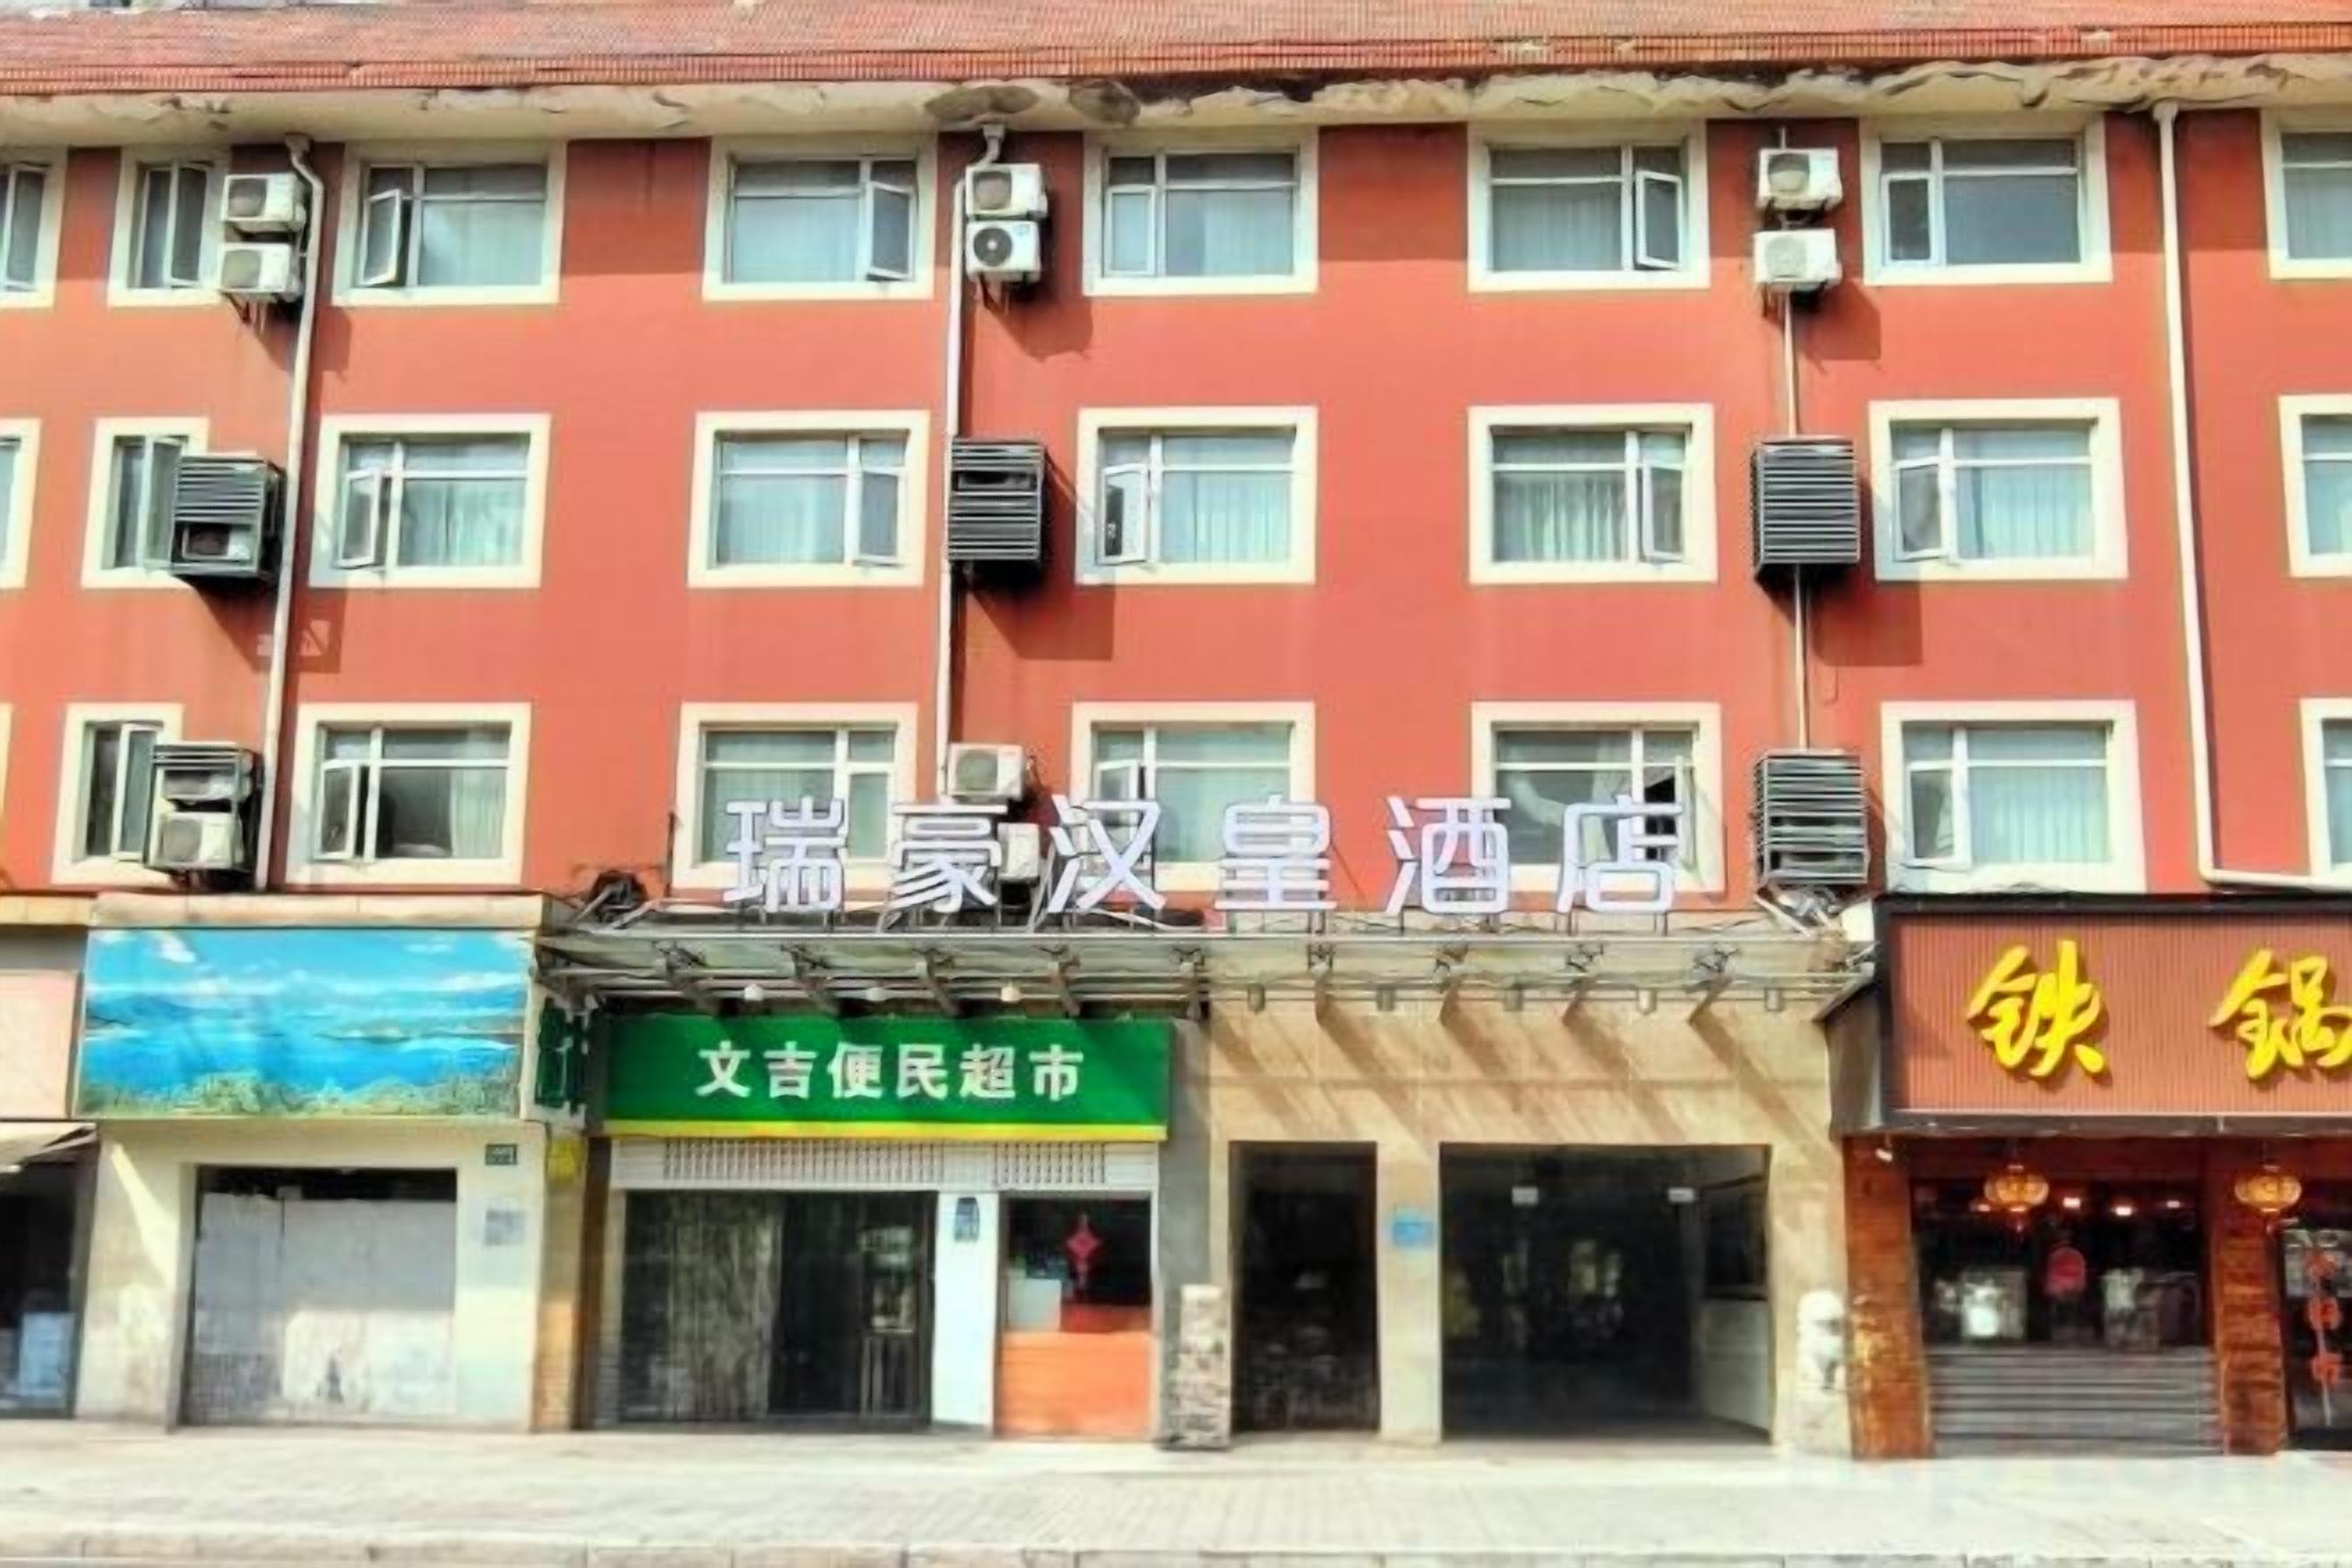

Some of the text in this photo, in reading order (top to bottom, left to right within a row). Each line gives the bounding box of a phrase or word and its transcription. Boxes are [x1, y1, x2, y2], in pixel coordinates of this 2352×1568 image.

[723, 795, 1683, 914] 瑞豪汉皇酒店
[1967, 940, 2352, 1079] 铁锅
[695, 1041, 1083, 1101] 文吉便民超市
